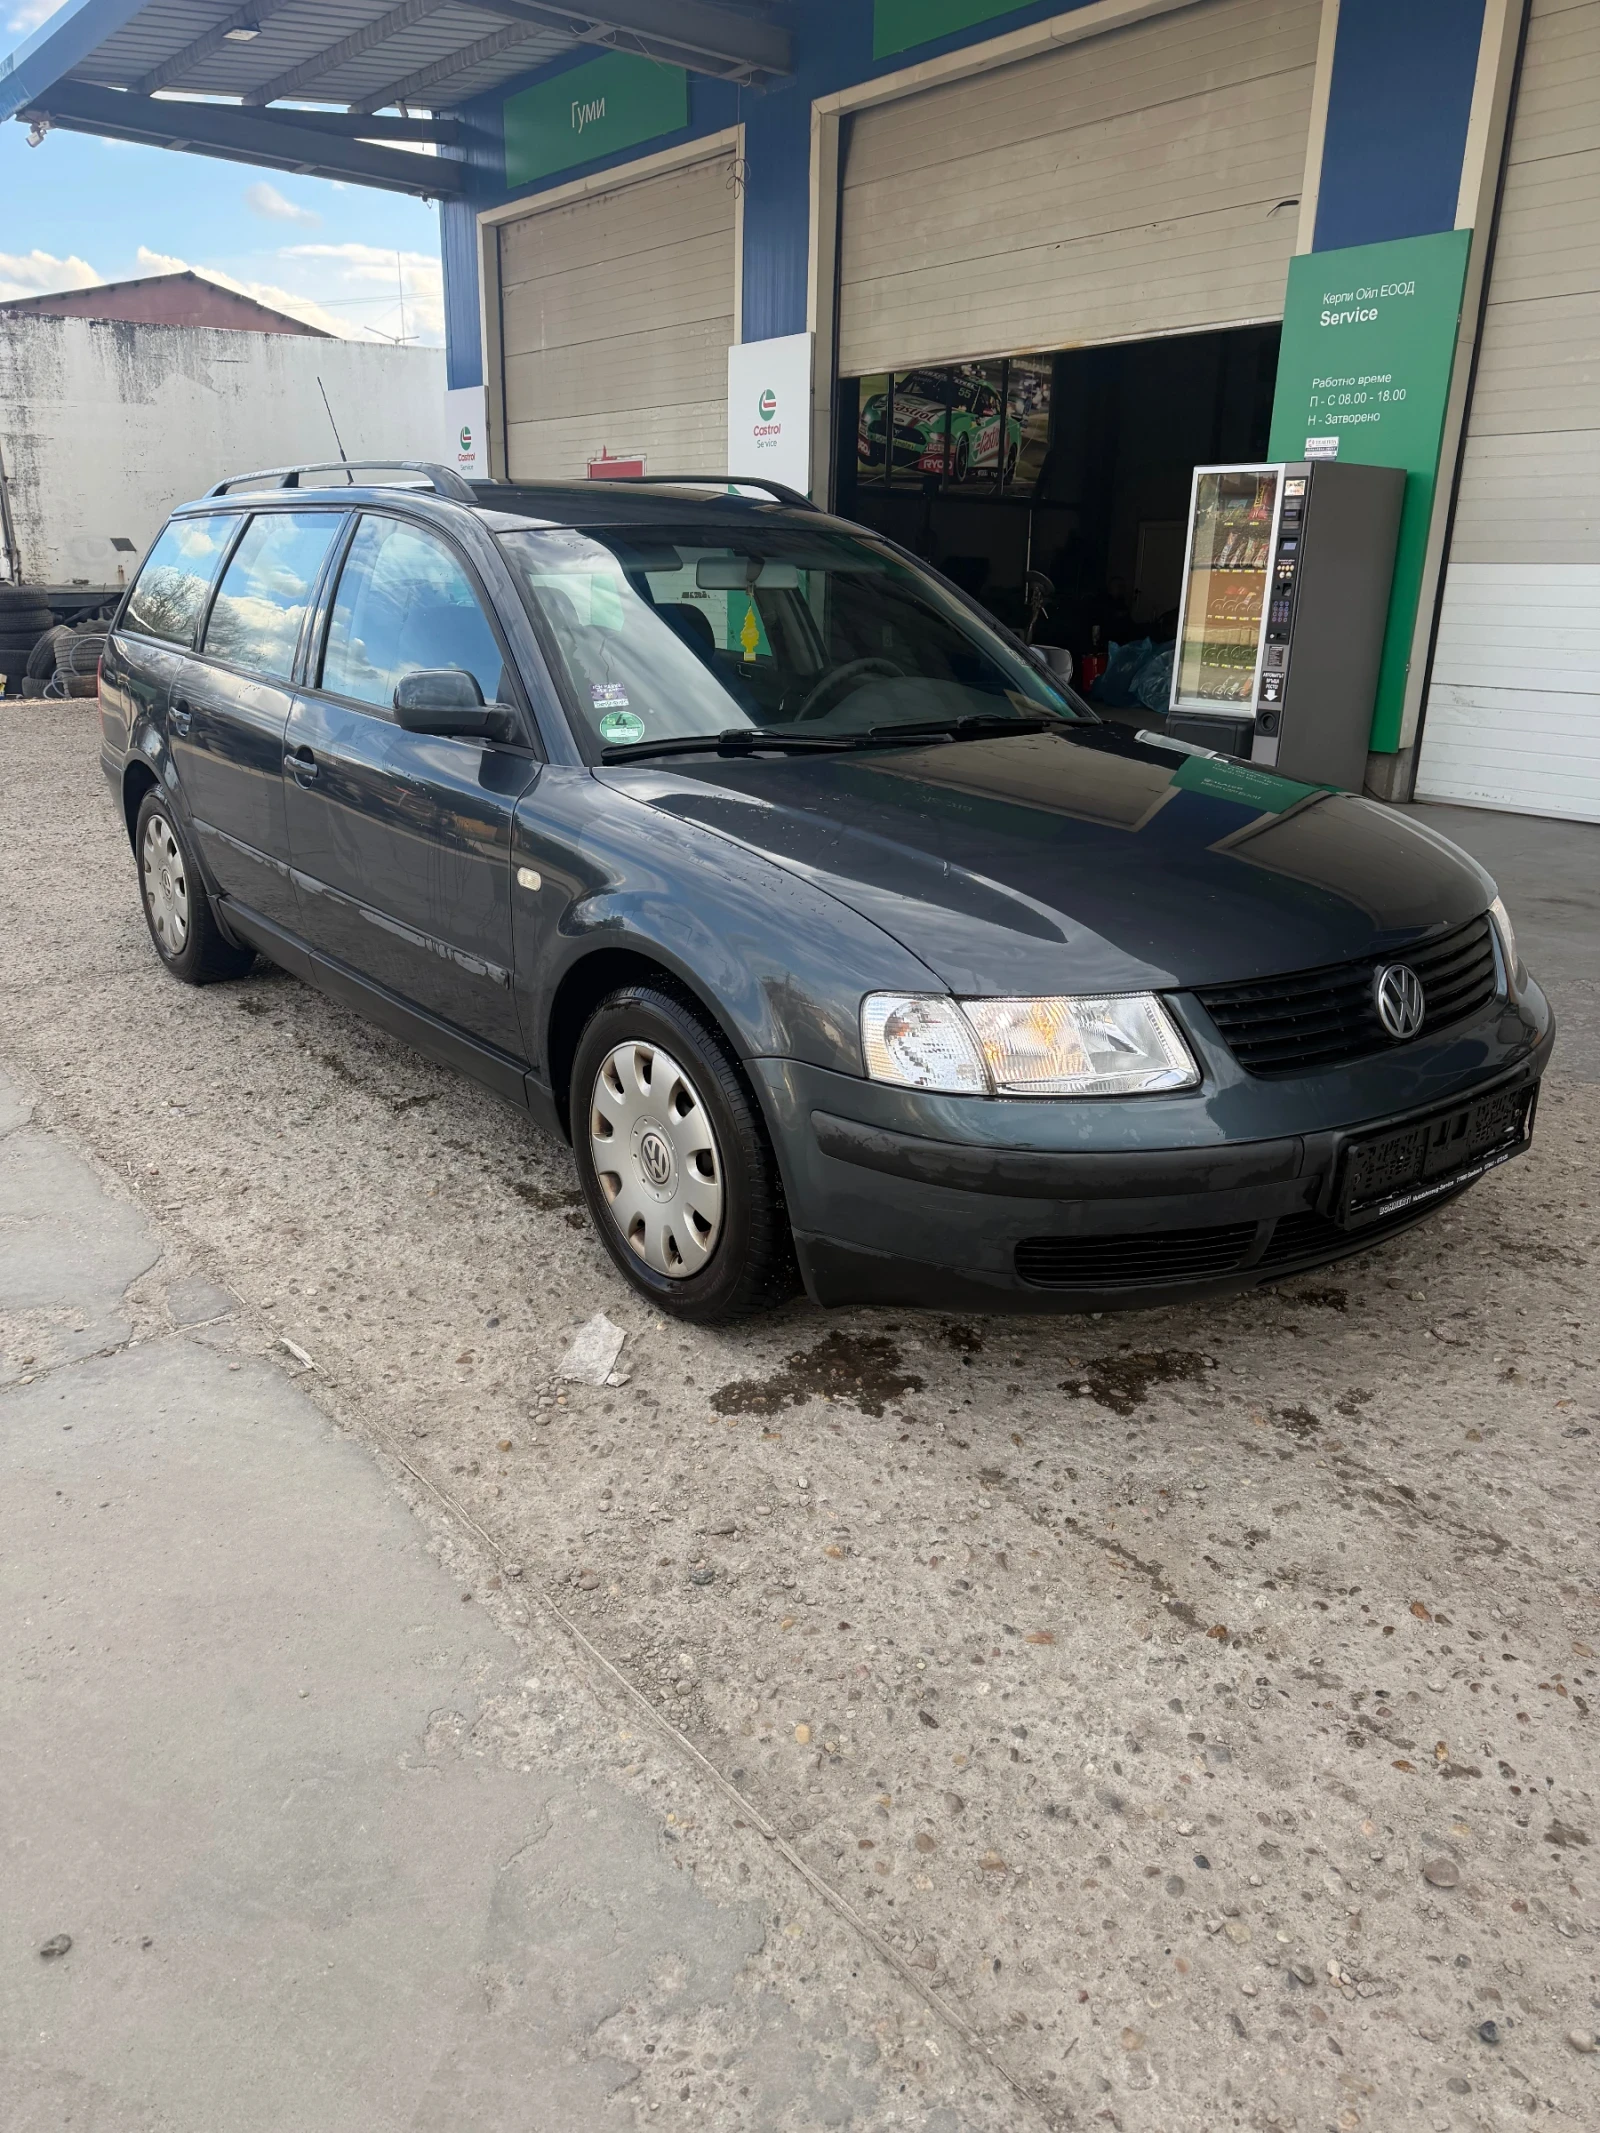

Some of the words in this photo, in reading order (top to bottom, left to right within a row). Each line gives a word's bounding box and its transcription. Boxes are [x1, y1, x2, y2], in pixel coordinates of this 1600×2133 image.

[571, 97, 606, 134] Гуми
[1322, 291, 1354, 306] Керпи
[1355, 286, 1379, 301] Ойл
[1380, 280, 1416, 297] ЕООД
[1319, 306, 1379, 327] Service
[1312, 376, 1356, 389] Работно
[1357, 373, 1392, 387] време
[1338, 391, 1367, 405] 08.00
[1377, 388, 1407, 402] 18.00
[1324, 412, 1381, 425] Затворено
[753, 423, 782, 437] Castrol
[756, 438, 778, 449] Service
[458, 452, 476, 462] Castrol
[615, 713, 628, 726] 4
